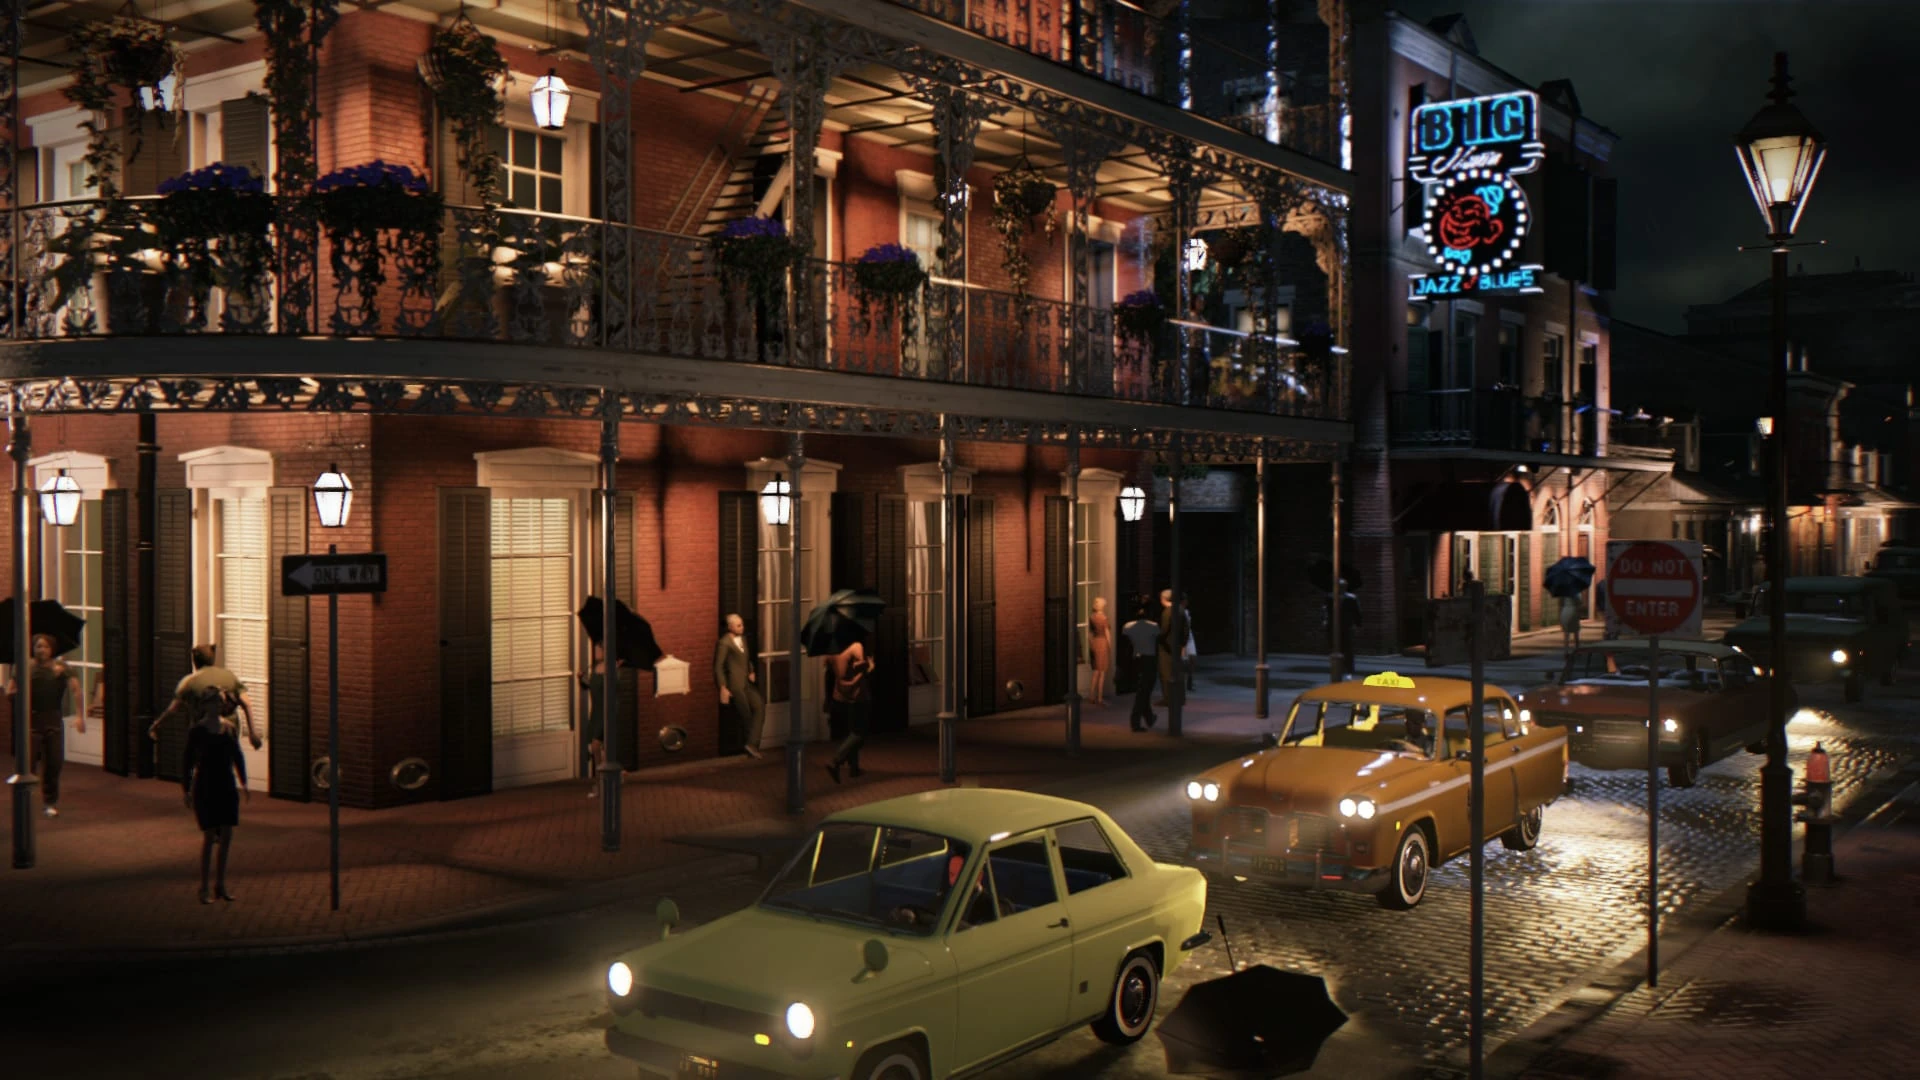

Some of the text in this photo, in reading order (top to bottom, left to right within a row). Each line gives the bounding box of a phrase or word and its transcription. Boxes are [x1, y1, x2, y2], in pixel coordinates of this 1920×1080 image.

[1420, 96, 1525, 152] BIG
[1416, 270, 1536, 295] JAZZ BLUES
[313, 565, 375, 583] ONE WAY
[1619, 558, 1686, 575] DO NOT
[1625, 599, 1680, 617] ENTER
[1376, 677, 1400, 685] TAXI
